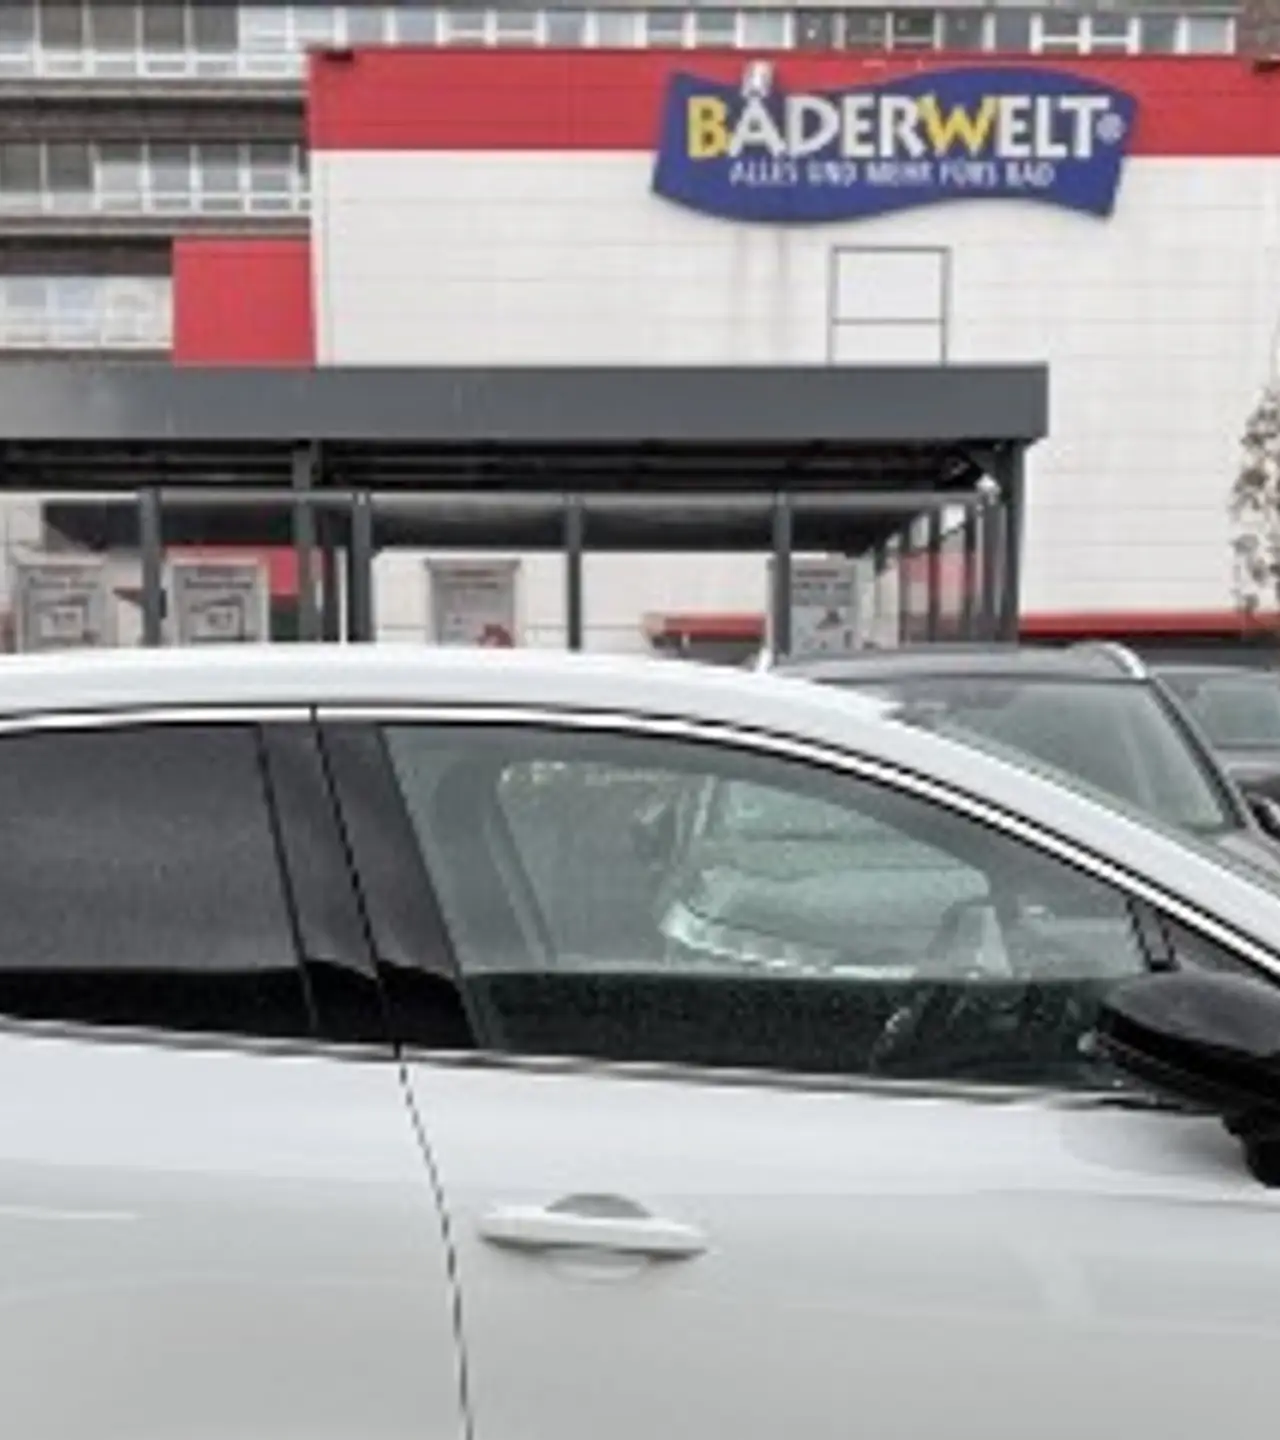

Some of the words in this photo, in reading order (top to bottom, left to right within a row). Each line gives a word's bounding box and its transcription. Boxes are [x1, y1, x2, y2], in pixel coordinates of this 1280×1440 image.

[729, 161, 798, 187] ALLES
[807, 161, 856, 186] UND
[1005, 159, 1056, 187] BAD
